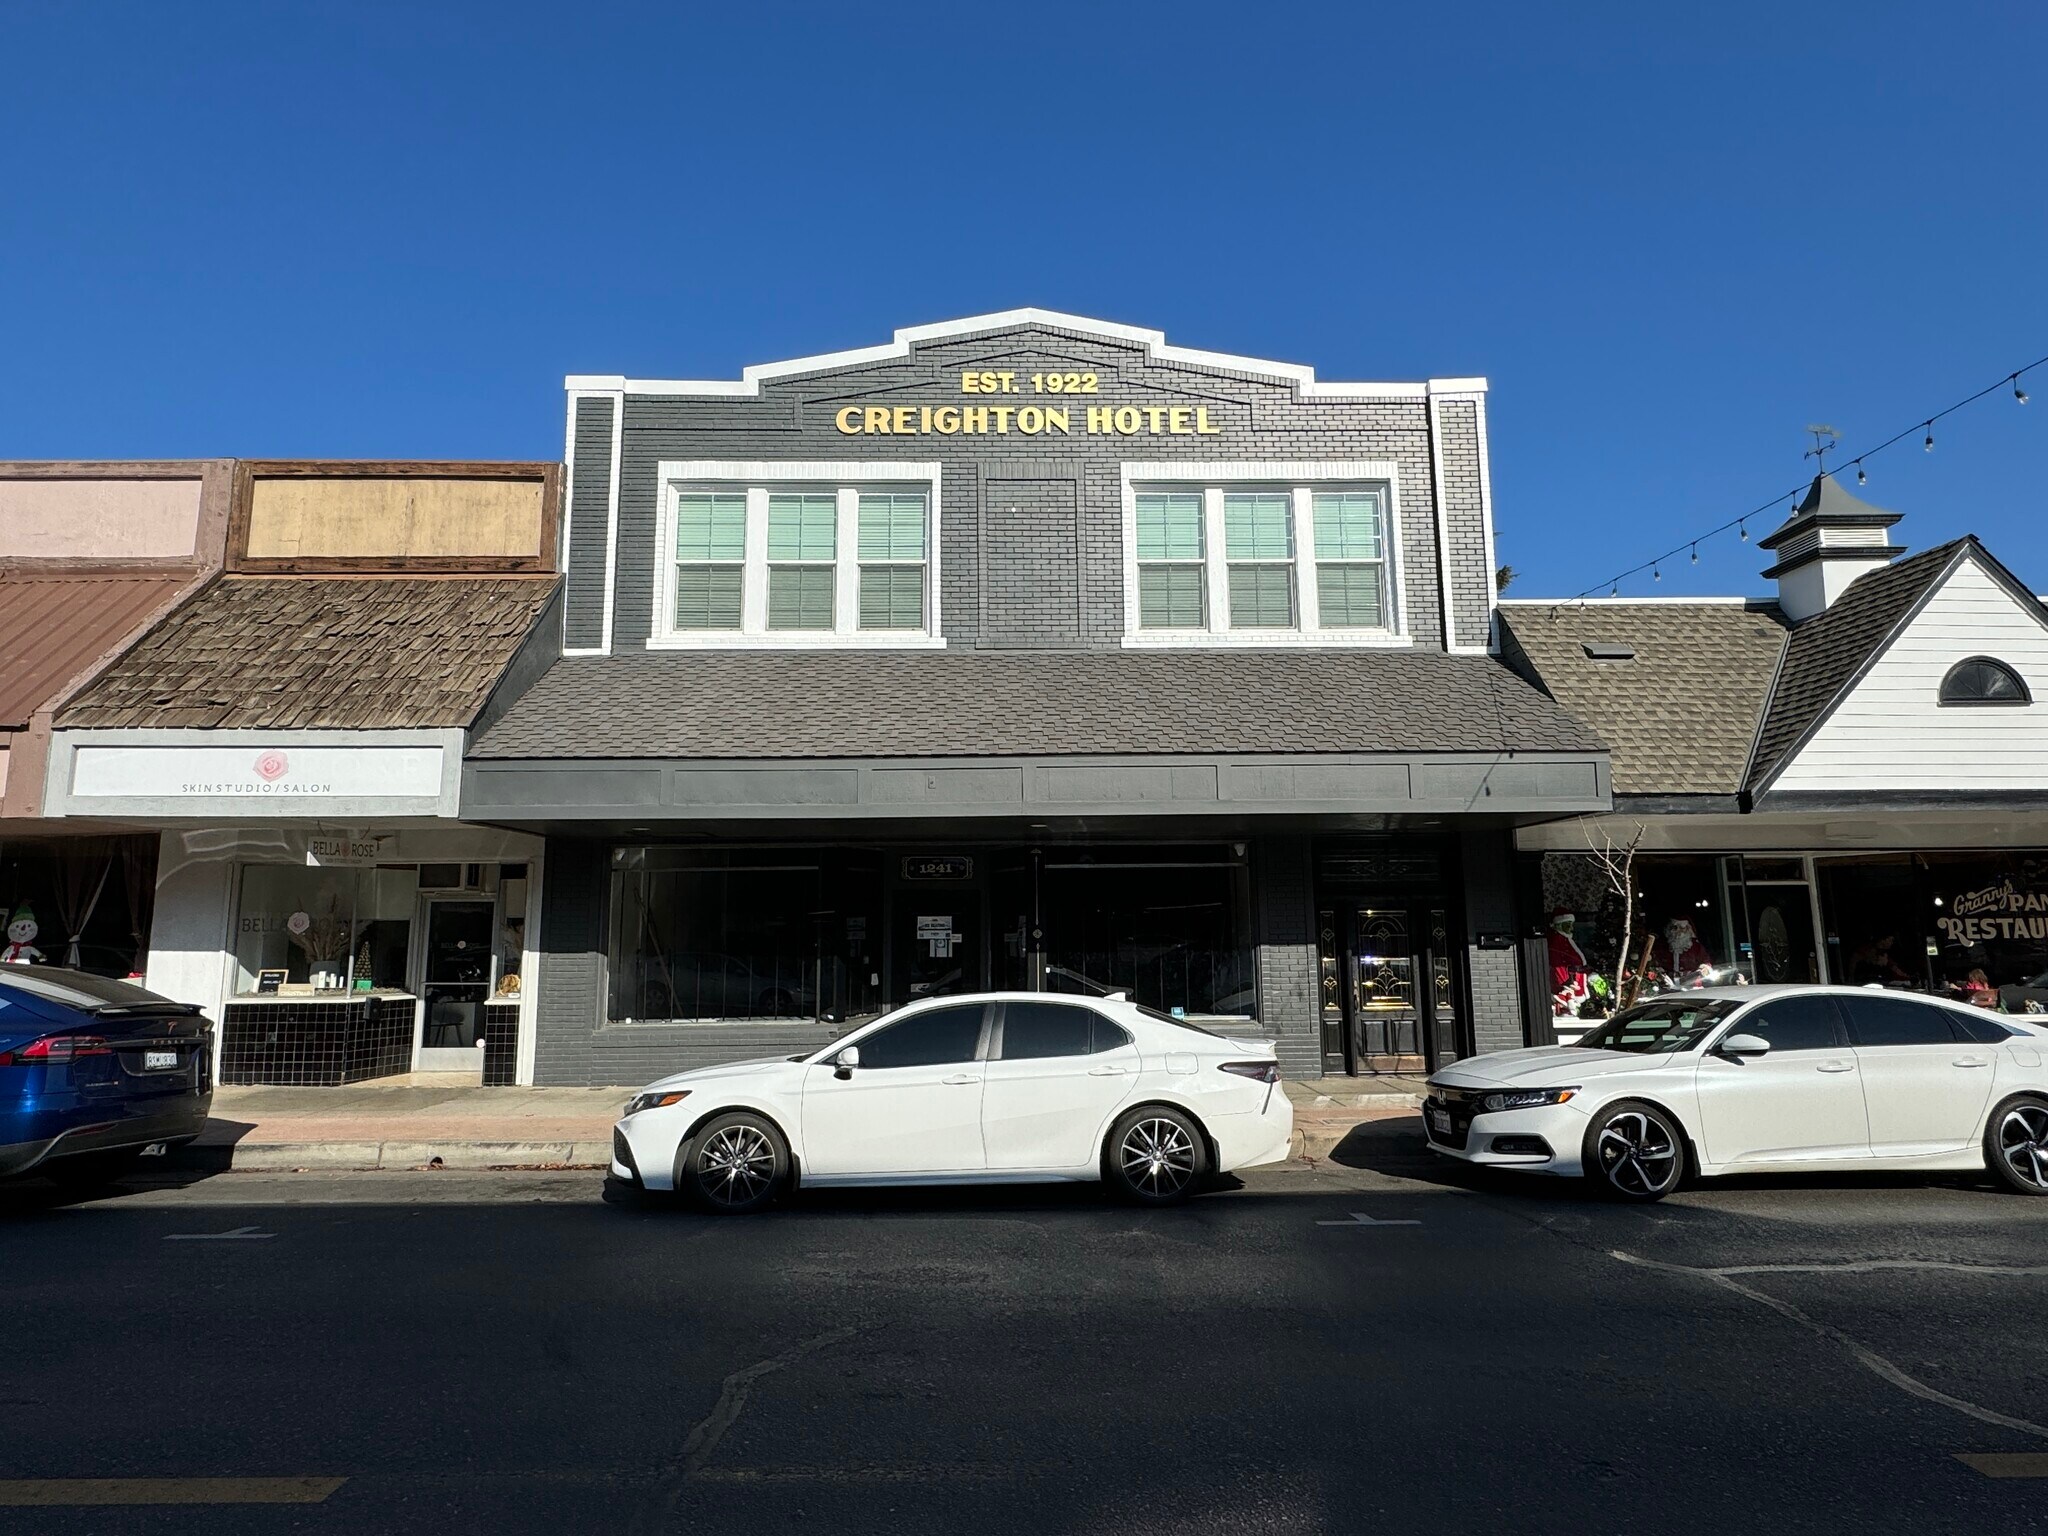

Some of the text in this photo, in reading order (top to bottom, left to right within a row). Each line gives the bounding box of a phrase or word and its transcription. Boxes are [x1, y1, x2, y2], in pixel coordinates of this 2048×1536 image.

[961, 372, 1099, 394] EST. 1922
[835, 406, 1221, 436] CREIGHTON HOTEL
[312, 841, 374, 857] BELLA ROSE
[919, 863, 952, 873] 1241
[1953, 879, 2014, 916] Granny's
[1937, 917, 2048, 947] RESTAU
